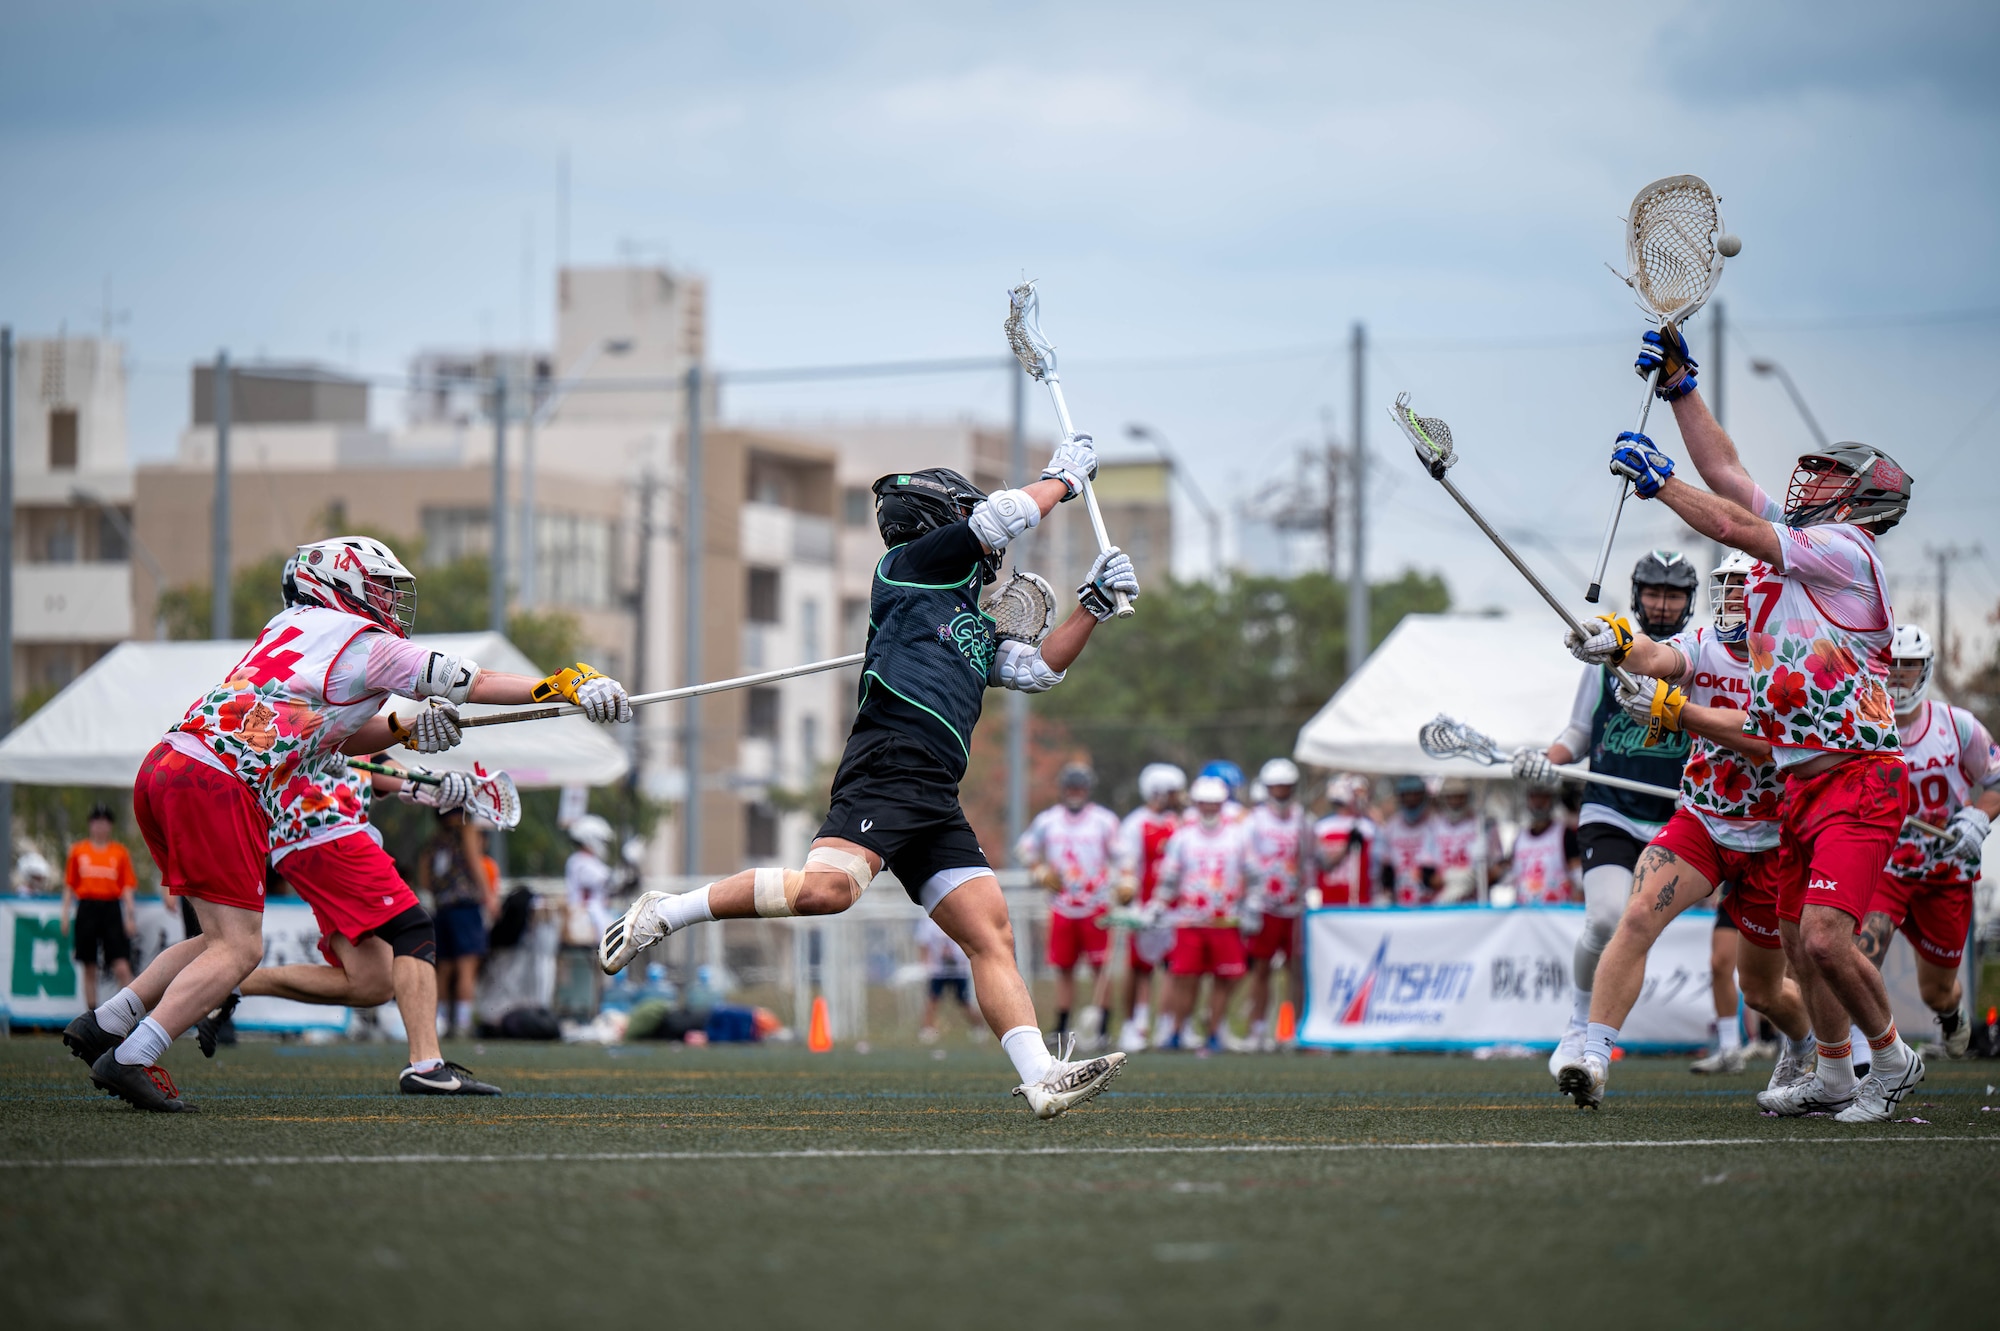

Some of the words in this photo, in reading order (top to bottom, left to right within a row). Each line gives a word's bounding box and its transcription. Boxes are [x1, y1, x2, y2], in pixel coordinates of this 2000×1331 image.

[333, 553, 352, 572] 14
[1744, 582, 1783, 633] 7
[439, 658, 456, 686] STX
[1695, 672, 1749, 694] OKIL
[1650, 715, 1660, 739] STX
[1909, 754, 1955, 773] LAX
[1907, 775, 1949, 815] 0
[1808, 879, 1838, 891] LAX
[1741, 916, 1780, 937] OKILA
